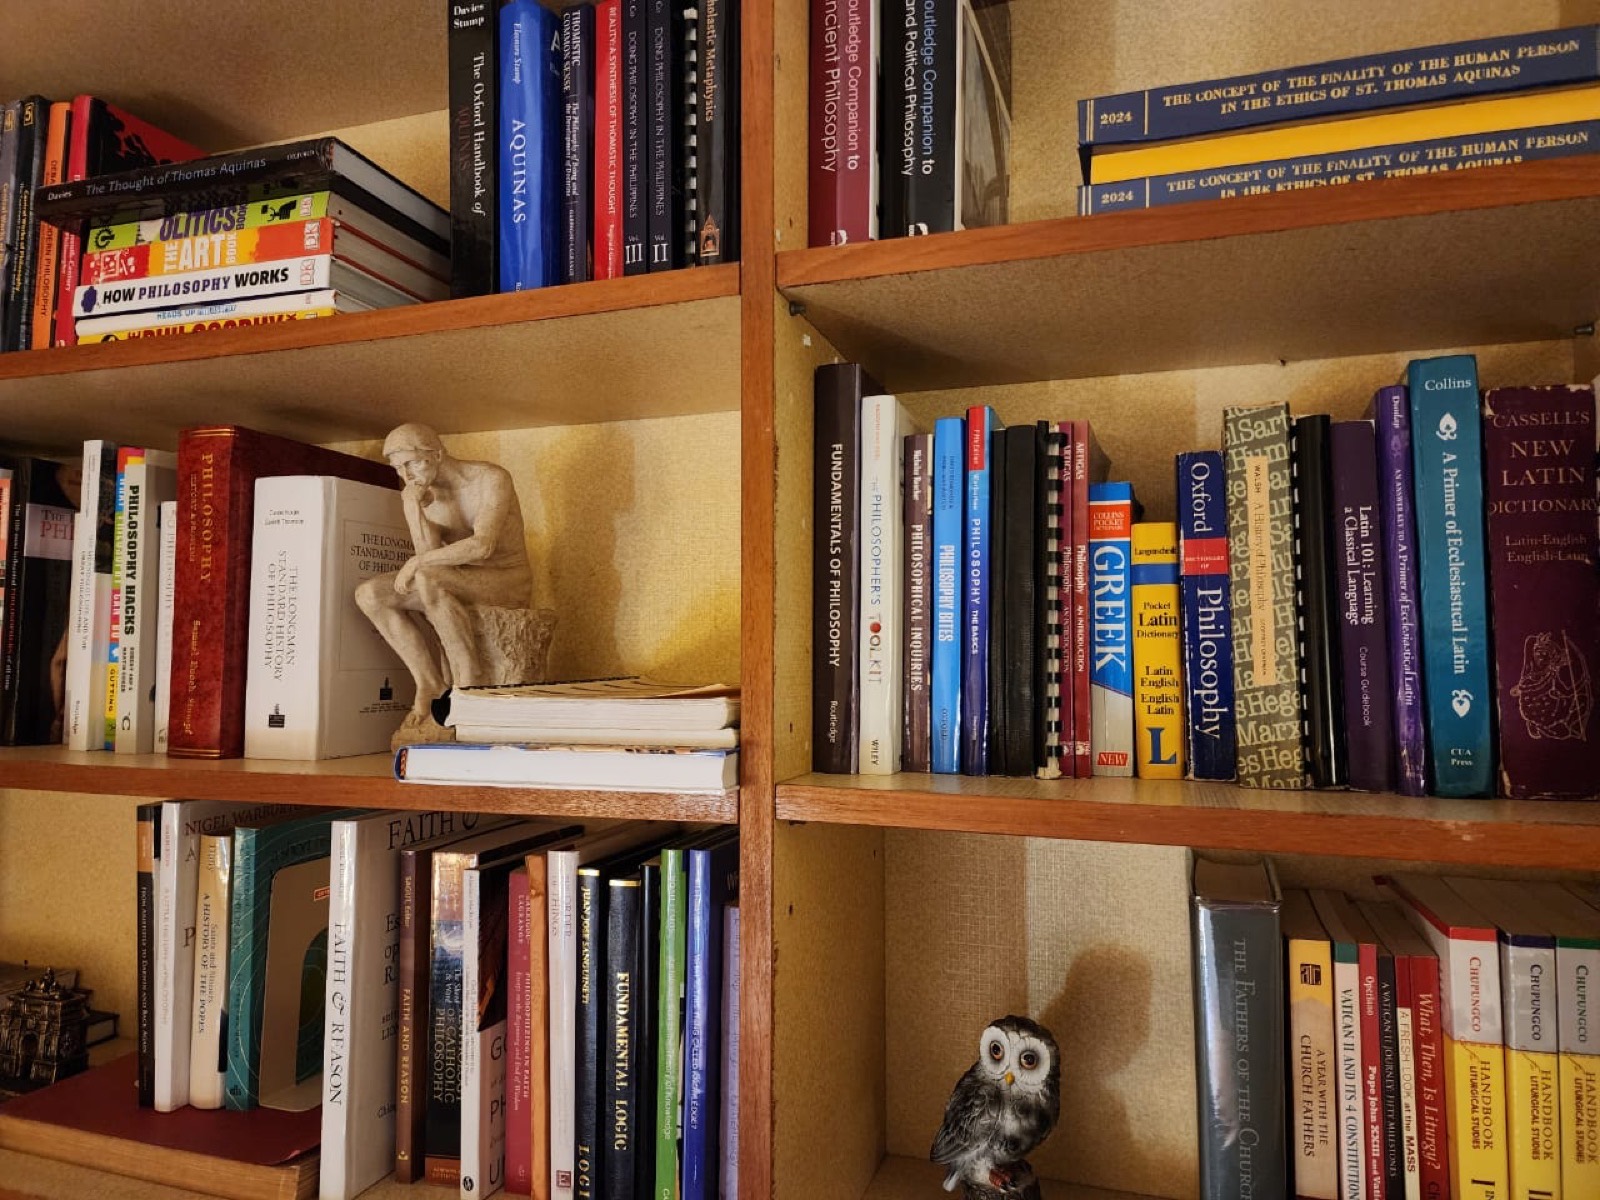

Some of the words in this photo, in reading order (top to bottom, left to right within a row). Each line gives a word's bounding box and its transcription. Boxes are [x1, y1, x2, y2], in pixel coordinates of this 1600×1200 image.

[454, 5, 484, 16] Davies
[454, 19, 485, 29] Stump
[905, 0, 917, 27] and
[572, 10, 580, 66] THOMISTIC
[824, 0, 840, 62] ncient
[845, 0, 861, 62] outledge
[921, 0, 937, 65] outledge
[474, 52, 484, 79] The
[905, 31, 916, 90] Political
[1163, 91, 1192, 107] THE
[1196, 84, 1256, 103] CONCEPT
[1262, 78, 1282, 93] OF
[1287, 72, 1316, 89] THE
[1320, 64, 1386, 85] FINALITY
[1393, 60, 1416, 75] OF
[1419, 54, 1450, 71] THE
[1454, 47, 1510, 67] HUMAN
[1518, 40, 1580, 59] PERSON
[473, 83, 485, 127] Oxford
[1221, 102, 1237, 115] IN
[1242, 95, 1271, 112] THE
[1277, 88, 1326, 107] ETHICS
[1330, 85, 1350, 99] OF
[1356, 83, 1378, 96] ST.
[1384, 74, 1447, 92] THOMAS
[1454, 64, 1521, 84] AQUINAS
[822, 69, 839, 172] Philosophy
[846, 66, 861, 151] Companion
[920, 70, 936, 155] Companion
[1100, 111, 1133, 125] 2024
[901, 95, 916, 175] Philosophy
[86, 184, 106, 195] The
[109, 175, 152, 193] Thought
[157, 172, 169, 184] of
[172, 166, 216, 181] Thomas
[220, 157, 266, 175] Aquinas
[473, 131, 485, 198] Handbook
[510, 119, 526, 223] AQUINAS
[849, 155, 860, 170] to
[922, 159, 935, 175] to
[48, 190, 72, 201] Davies
[473, 202, 485, 217] of
[164, 240, 178, 272] THE
[178, 235, 226, 269] ART
[103, 288, 135, 304] HOW
[139, 276, 230, 300] PHILOSOPHY
[235, 268, 289, 288] WORKS
[1424, 377, 1472, 392] Collins
[1493, 411, 1590, 429] CASSELL'S
[1076, 442, 1085, 480] ARTIGAS
[1442, 452, 1458, 465] A
[1509, 439, 1575, 458] NEW
[1253, 465, 1262, 494] WALSH
[1443, 468, 1460, 516] Primer
[1503, 465, 1586, 487] LATIN
[828, 443, 842, 554] FUNDAMENTALS
[1190, 462, 1212, 532] Oxford
[125, 485, 140, 580] PHILOSOPHY
[200, 453, 214, 583] PHILOSOPHY
[1359, 505, 1374, 537] Latin
[1445, 520, 1461, 536] of
[1345, 517, 1359, 566] Classical
[1361, 541, 1375, 568] 101:
[267, 563, 277, 582] OF
[828, 559, 841, 576] OF
[910, 524, 923, 622] PHILOSOPHICAL
[939, 545, 954, 609] PHILOSOPHY
[970, 518, 981, 604] PHILOSOPHY
[1074, 544, 1086, 594] Philosophy
[277, 550, 287, 621] STANDARD
[288, 566, 298, 593] THE
[1344, 570, 1360, 625] Language
[1447, 537, 1466, 632] Ecclesiastical
[124, 585, 138, 635] HACKS
[1077, 604, 1085, 615] AN
[1093, 545, 1126, 673] GREEK
[1143, 601, 1171, 610] Pocket
[1360, 572, 1377, 625] Learning
[264, 585, 276, 669] PHILOSOPHY
[286, 596, 297, 665] LONGMAN
[828, 580, 841, 666] PHILOSOPHY
[938, 612, 954, 642] BITES
[1137, 629, 1179, 640] Dictionary
[1138, 613, 1177, 627] Latin
[273, 625, 285, 683] HISTORY
[910, 627, 923, 691] INQUIRIES
[1077, 617, 1085, 672] INTRODUCTION
[1359, 646, 1370, 677] Course
[1451, 637, 1468, 674] Latin
[1145, 665, 1173, 676] Latin
[1194, 587, 1228, 739] Philosophy
[107, 668, 117, 712] GUTTING
[1140, 676, 1179, 689] English
[1140, 693, 1180, 705] English
[1146, 704, 1175, 715] Latin
[1360, 679, 1372, 726] Guidebook
[827, 700, 838, 743] Routledge
[869, 739, 880, 766] WILEY
[1098, 753, 1128, 766] NEW
[1145, 726, 1177, 765] L
[202, 893, 210, 901] A
[200, 903, 210, 952] HISTORY
[200, 955, 209, 970] OF
[333, 922, 347, 983] FAITH
[1234, 940, 1247, 972] THE
[199, 974, 208, 995] THE
[1529, 964, 1543, 1040] CHUPUNGCO
[198, 999, 207, 1034] POPES
[333, 991, 347, 1016] &
[401, 989, 410, 1021] FAITH
[1235, 980, 1256, 1052] FATHERS
[1341, 989, 1354, 1039] VATICAN
[1399, 1011, 1409, 1019] A
[1418, 993, 1432, 1037] What,
[1576, 965, 1589, 1043] CHUPUNGCO
[401, 1025, 410, 1051] AND
[614, 972, 629, 1090] FUNDAMENTAL
[1343, 1043, 1354, 1051] II
[1400, 1023, 1411, 1062] FRESH
[329, 1023, 345, 1106] REASON
[400, 1056, 410, 1104] REASON
[1237, 1059, 1249, 1081] OF
[1300, 1035, 1313, 1095] CHURCH
[1317, 1060, 1326, 1085] YEAR
[1344, 1055, 1355, 1080] AND
[1367, 1066, 1377, 1093] Pope
[1420, 1043, 1435, 1081] Then,
[1344, 1084, 1356, 1101] ITS
[1402, 1066, 1413, 1100] LOOK
[1423, 1086, 1436, 1101] Is
[1238, 1085, 1250, 1121] THE
[1318, 1090, 1327, 1121] WITH
[1346, 1105, 1357, 1113] 4
[1368, 1096, 1378, 1123] John
[1404, 1102, 1413, 1113] at
[1575, 1078, 1584, 1128] LITURGICAL
[1585, 1072, 1597, 1164] HANDBOOK
[614, 1100, 627, 1150] LOGIC
[1302, 1099, 1315, 1158] FATHERS
[1319, 1124, 1328, 1146] THE
[1370, 1125, 1379, 1156] XXIII
[1404, 1115, 1414, 1132] the
[1422, 1106, 1440, 1170] Liturgy?
[1345, 1116, 1359, 1200] CONSTITUTION
[1405, 1135, 1416, 1172] MASS
[1575, 1130, 1585, 1164] STUDIES
[1371, 1159, 1380, 1175] and
[1372, 1176, 1381, 1200] Vati
